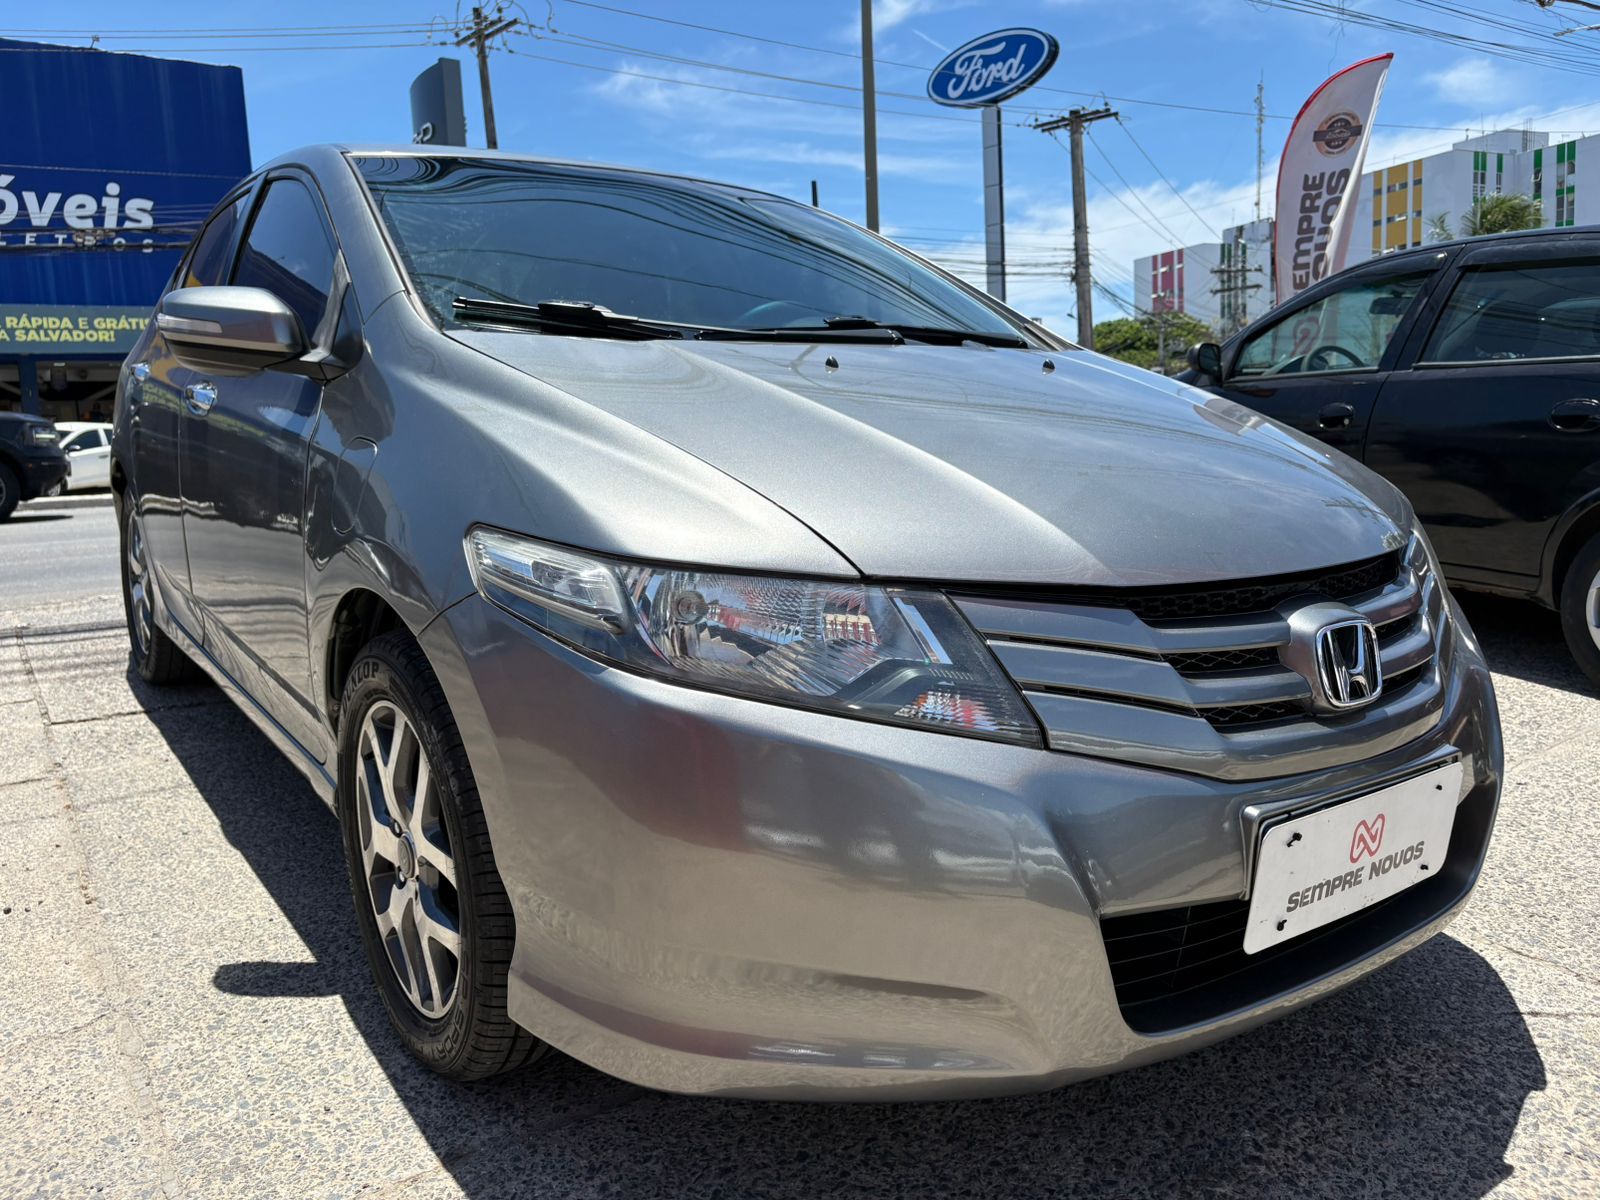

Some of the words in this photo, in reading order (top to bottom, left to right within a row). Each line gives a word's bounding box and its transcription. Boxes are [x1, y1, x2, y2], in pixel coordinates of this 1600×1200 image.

[947, 41, 1027, 99] Ford
[5, 313, 73, 329] RÁPIDA
[78, 317, 89, 330] E
[15, 329, 115, 343] SALVADOR!
[342, 661, 379, 717] DUNLOP
[1286, 865, 1365, 913] SEMPRE
